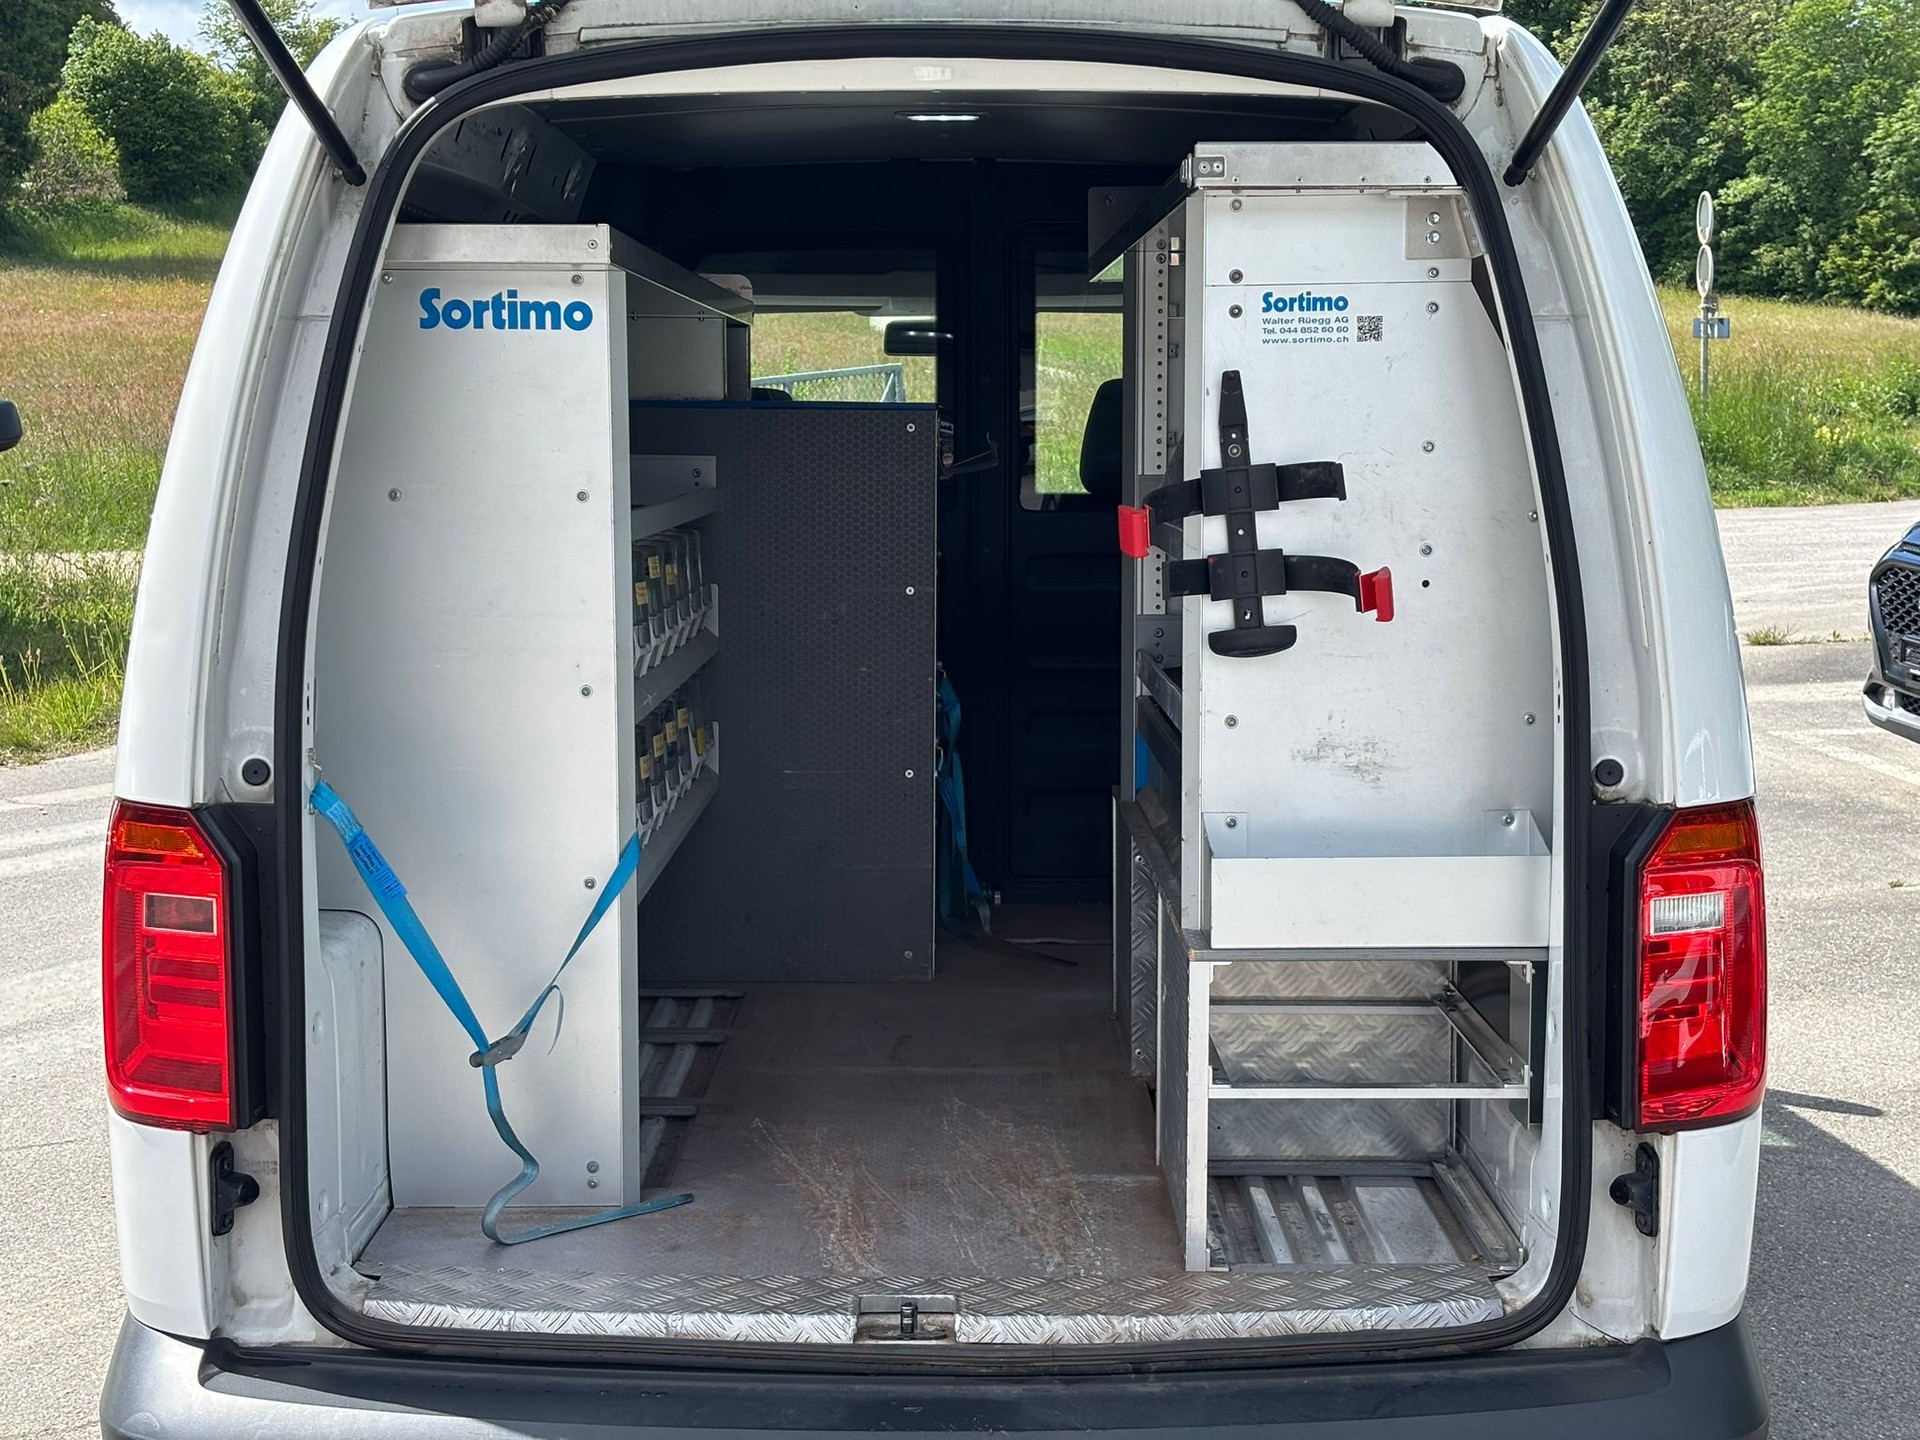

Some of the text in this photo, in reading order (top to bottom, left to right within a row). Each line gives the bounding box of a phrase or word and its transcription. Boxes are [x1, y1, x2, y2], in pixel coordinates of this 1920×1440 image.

[1262, 291, 1349, 313] Sortimo
[419, 287, 593, 331] Sortimo
[1262, 316, 1349, 325] Walter Rüegg AG
[1262, 327, 1277, 335] Tel.
[1300, 326, 1319, 334] 852
[1262, 336, 1349, 344] www.sortimo.ch
